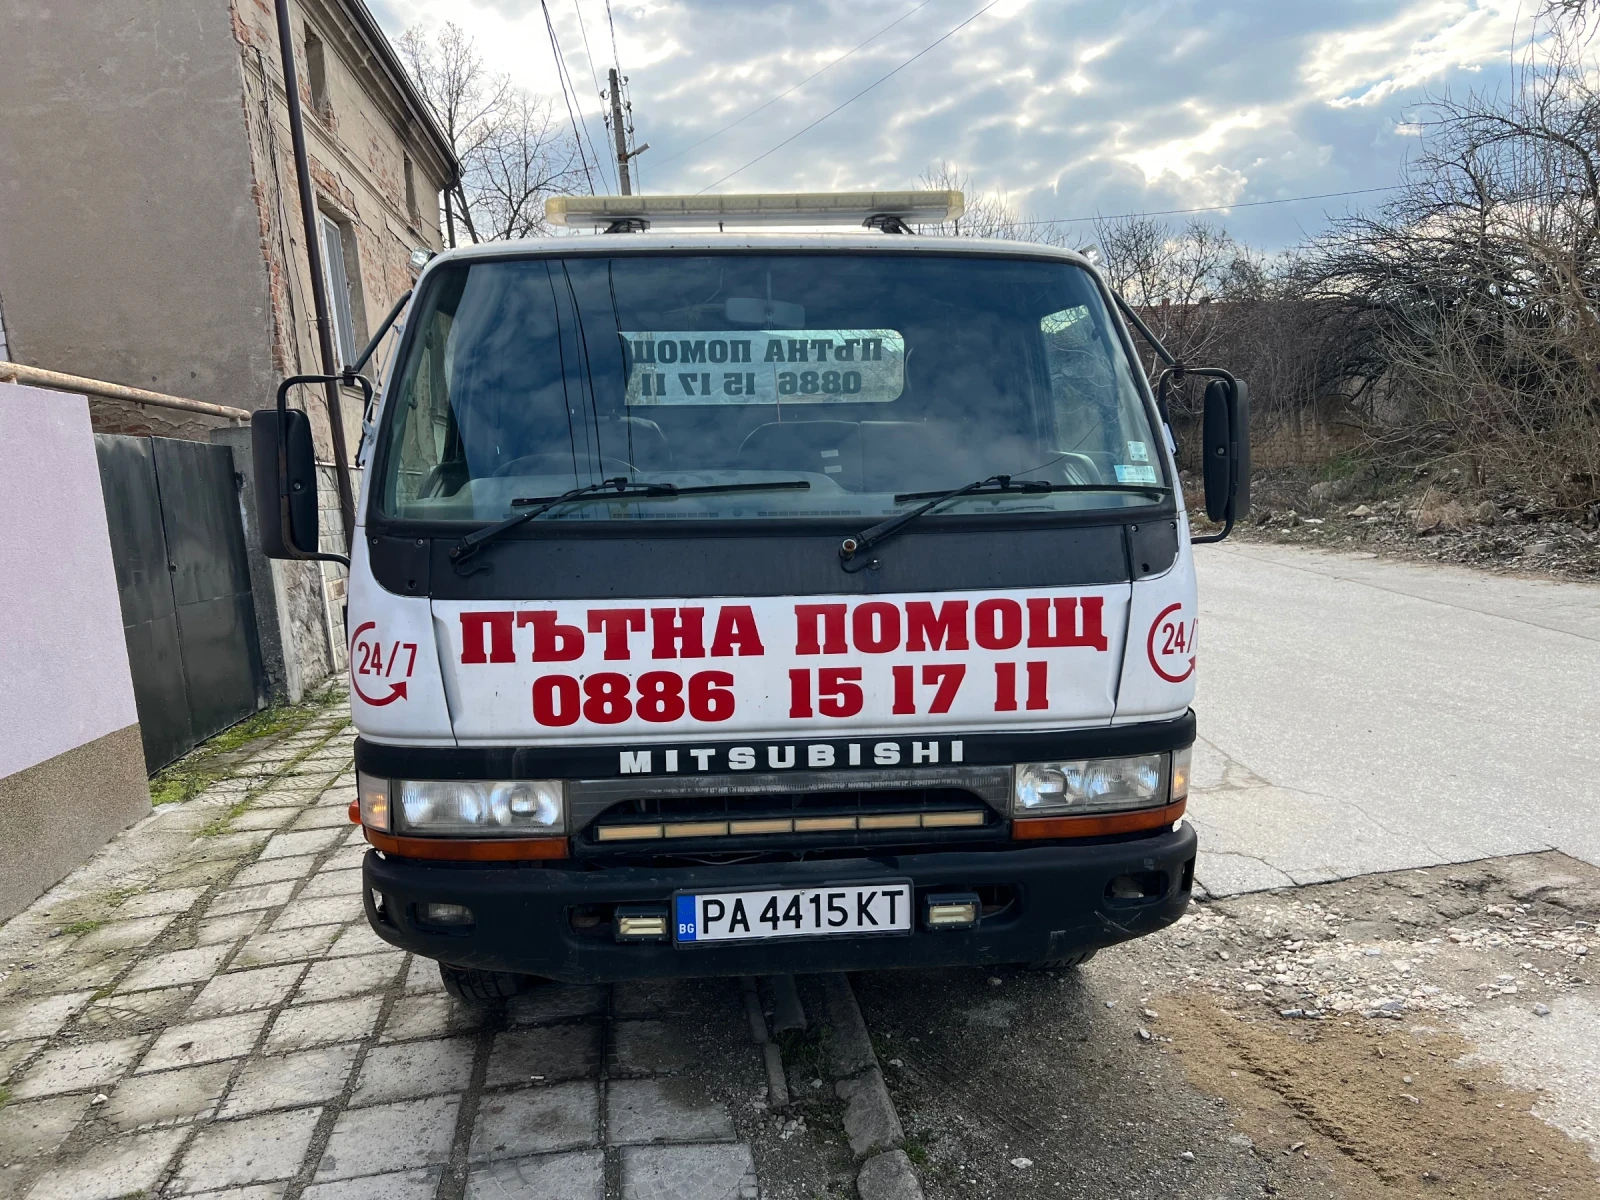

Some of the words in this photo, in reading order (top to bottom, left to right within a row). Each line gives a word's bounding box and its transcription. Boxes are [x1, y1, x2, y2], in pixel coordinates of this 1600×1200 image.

[459, 605, 765, 664] ПЪТНА
[794, 596, 1109, 656] ПОМОЩ
[357, 640, 418, 678] 24/7
[532, 670, 736, 727] 0886
[788, 667, 864, 718] 15
[892, 663, 967, 715] 17
[994, 661, 1050, 712] 11
[619, 740, 964, 774] MITSUBISHI
[678, 923, 695, 935] BG
